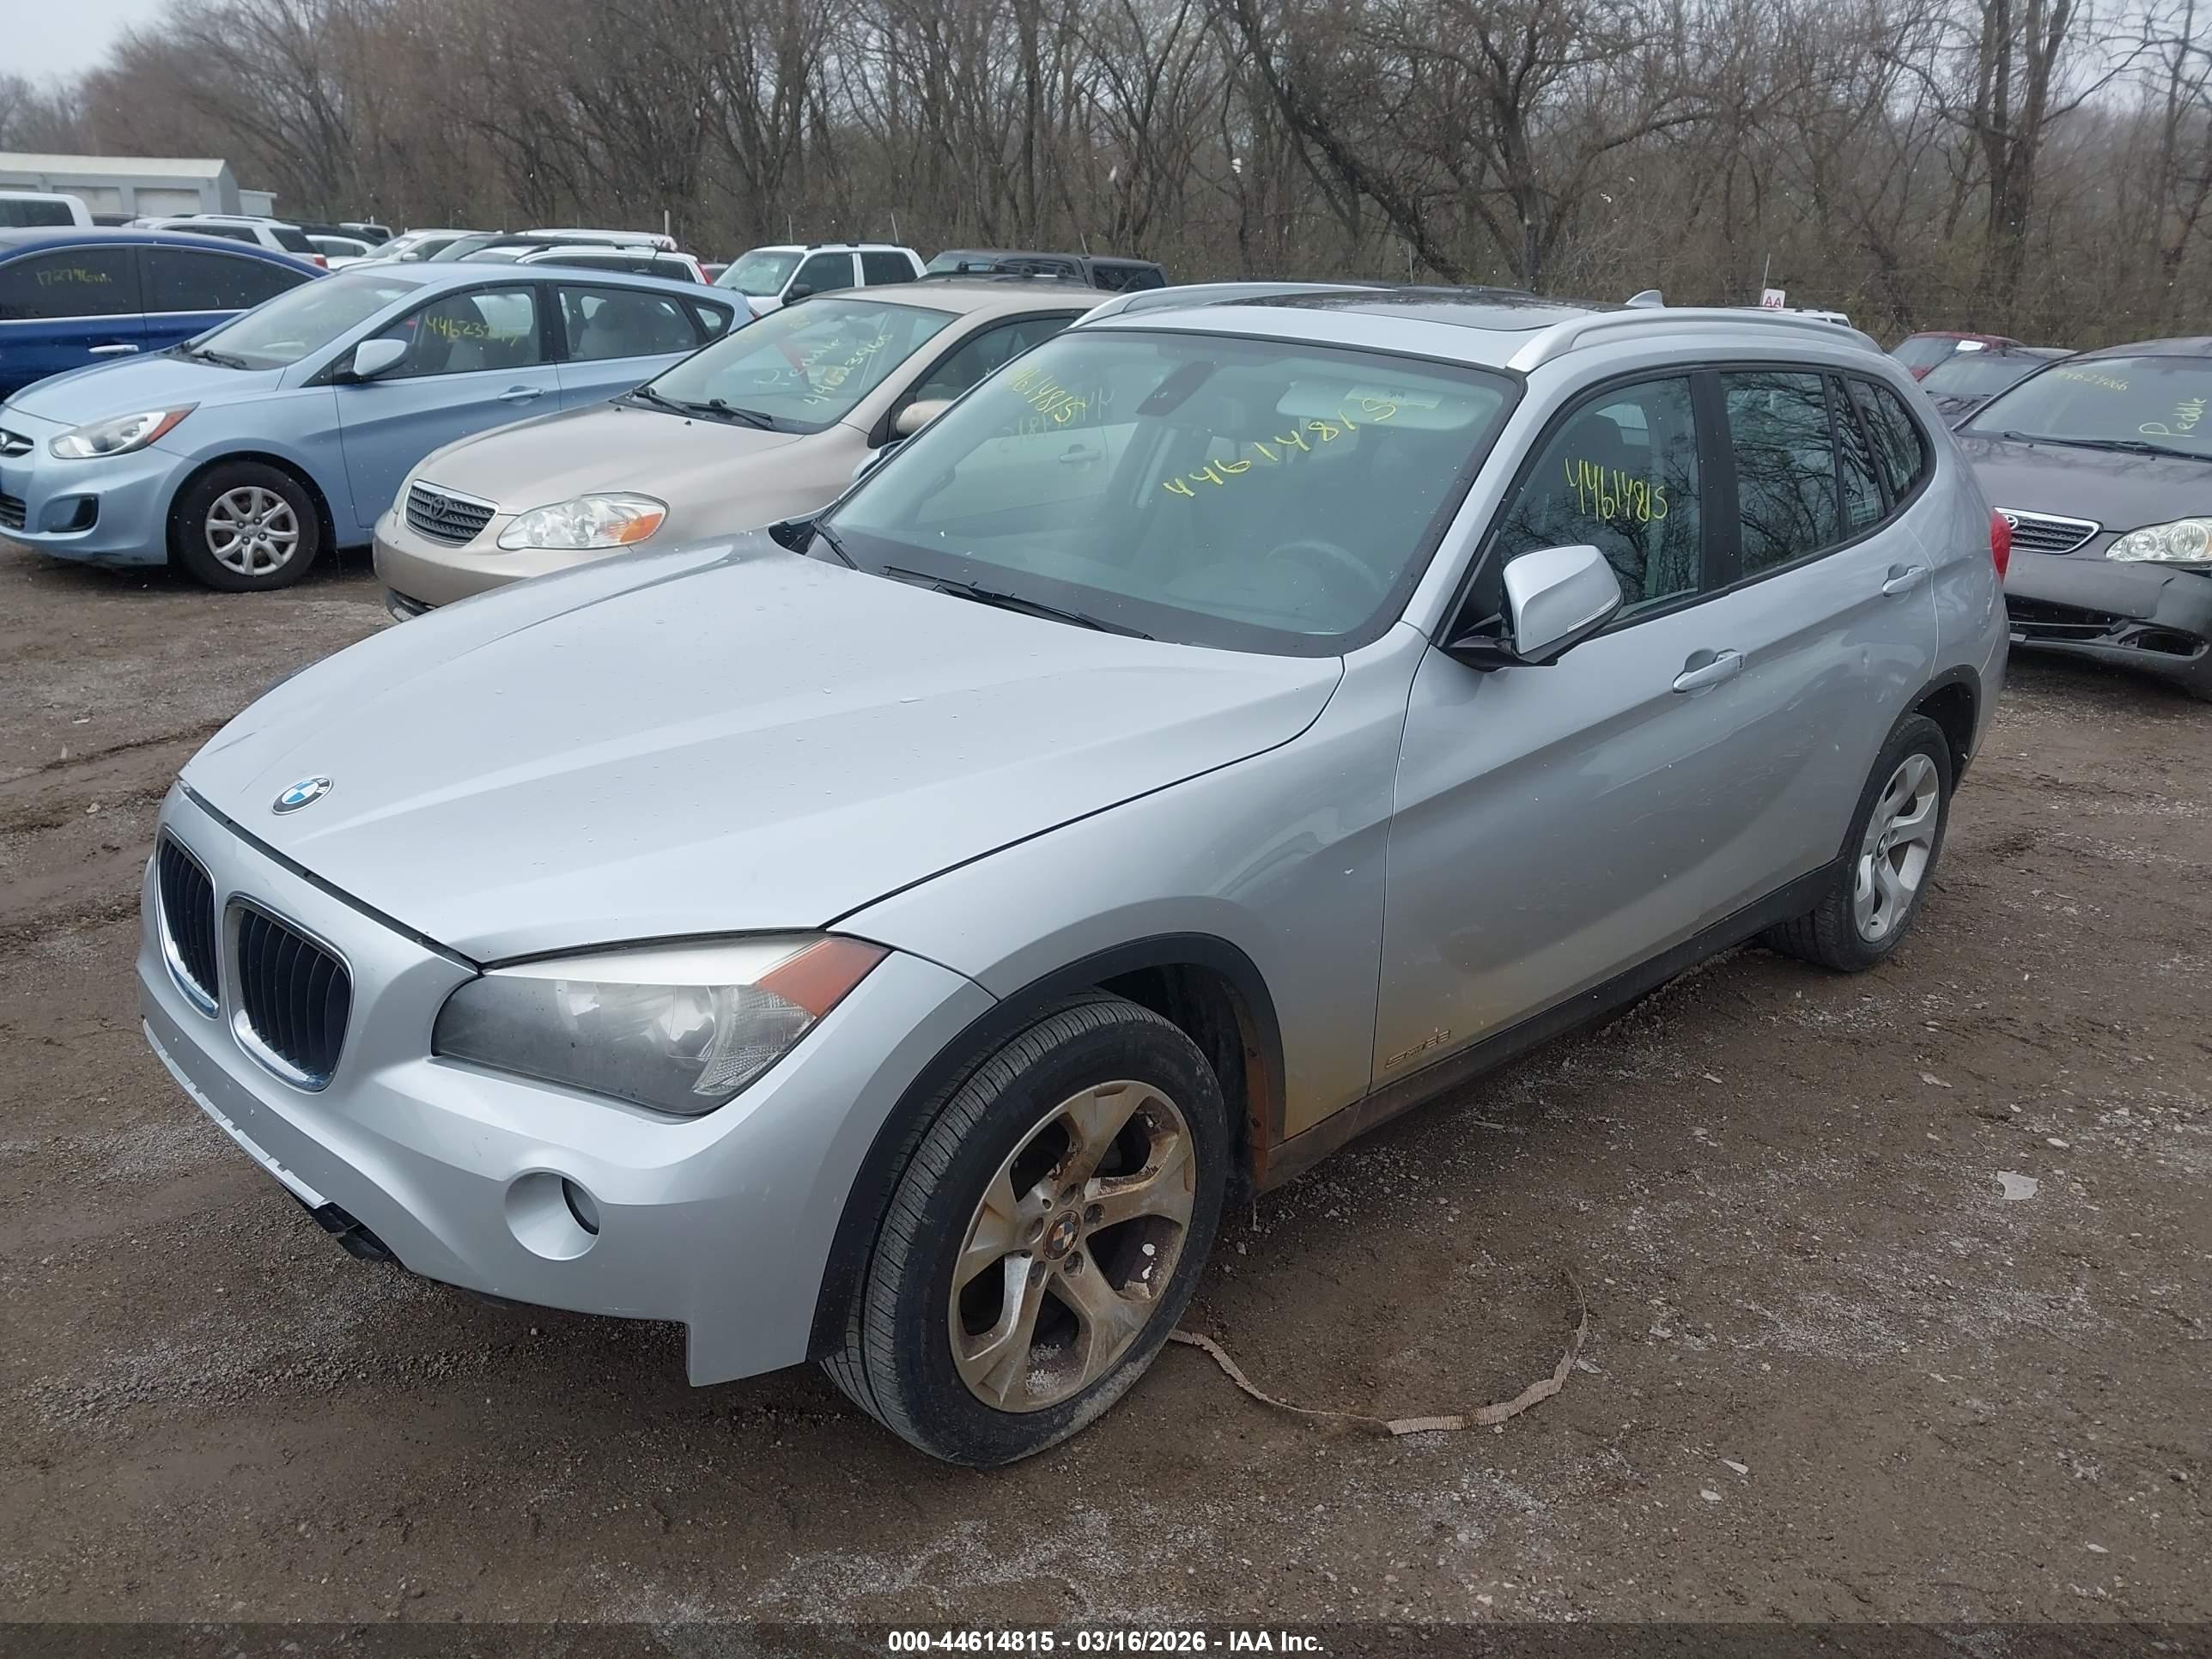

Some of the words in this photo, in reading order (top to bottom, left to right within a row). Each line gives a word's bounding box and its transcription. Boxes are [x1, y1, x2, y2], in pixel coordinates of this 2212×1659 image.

[1008, 368, 1086, 423] 614815
[2138, 397, 2208, 439] Peddle
[1163, 398, 1396, 497] 44614815
[1565, 457, 1668, 526] 44614815
